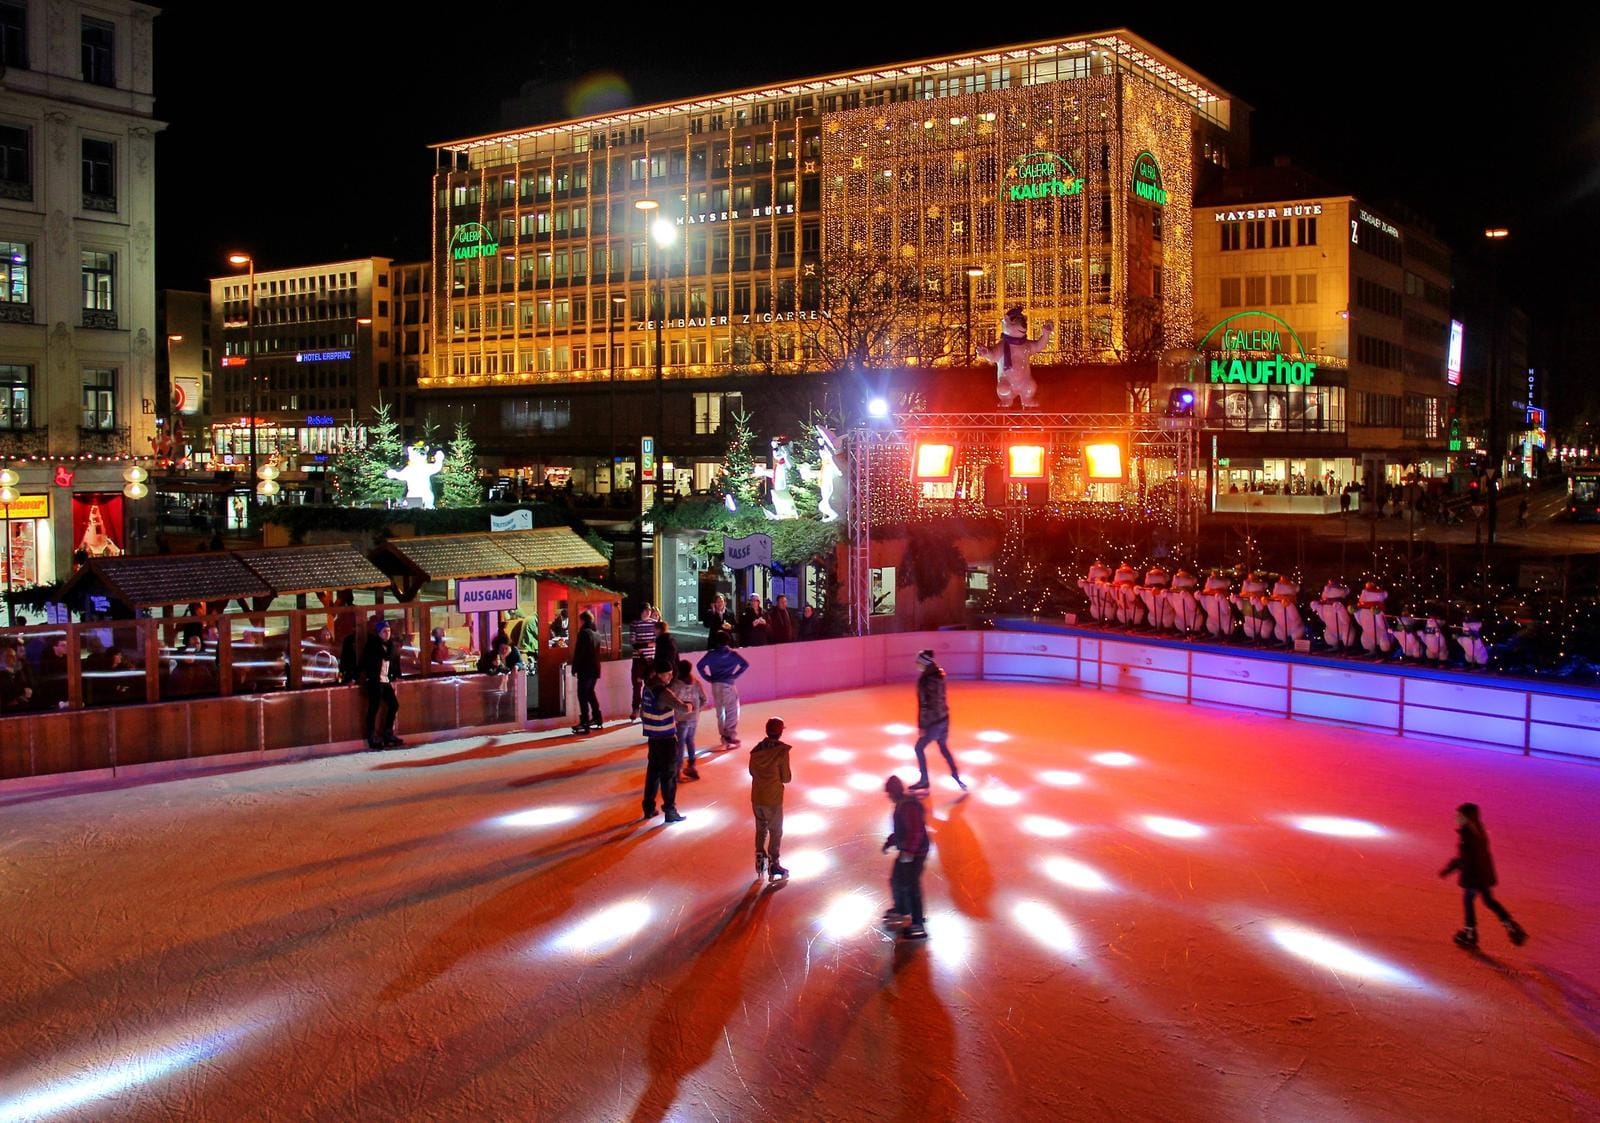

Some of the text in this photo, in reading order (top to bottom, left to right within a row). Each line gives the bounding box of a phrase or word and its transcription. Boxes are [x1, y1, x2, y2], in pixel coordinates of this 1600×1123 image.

[1019, 162, 1056, 179] GALERIA
[676, 211, 739, 226] MAYSER
[1215, 204, 1322, 222] MAYSER HÜTE
[1224, 329, 1282, 351] GALERIA
[303, 353, 321, 362] HOTEL
[644, 440, 651, 452] U
[728, 545, 751, 560] KASSE
[463, 589, 513, 602] AUSGANG
